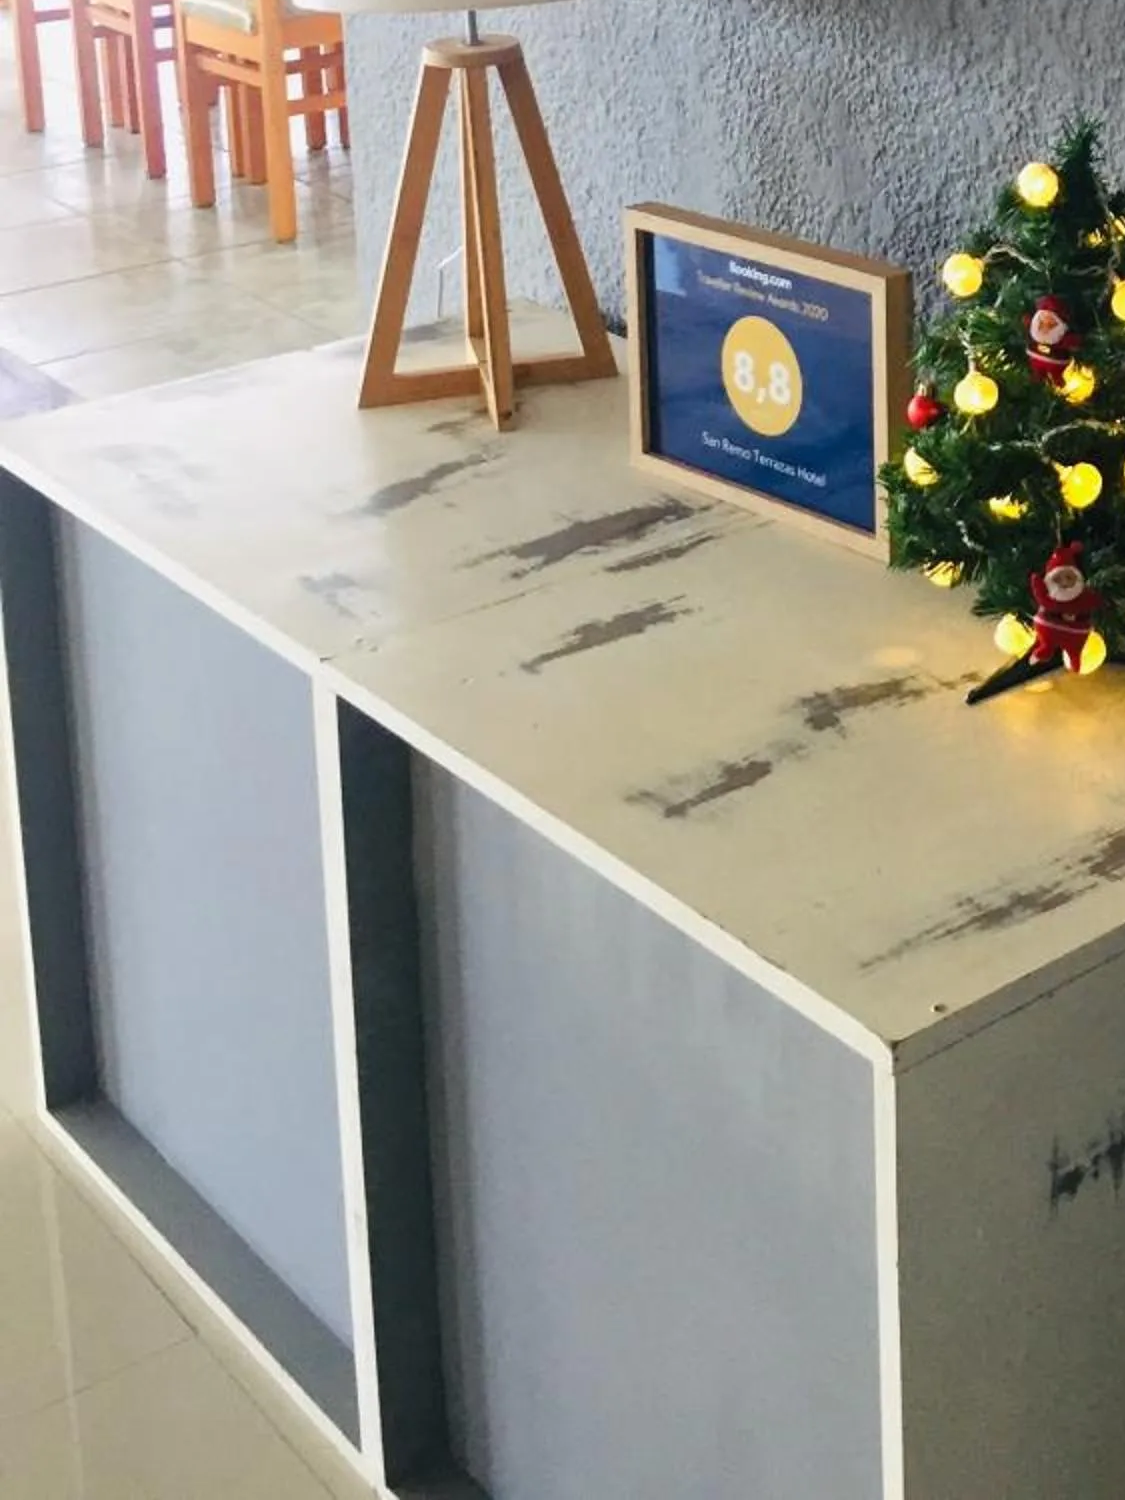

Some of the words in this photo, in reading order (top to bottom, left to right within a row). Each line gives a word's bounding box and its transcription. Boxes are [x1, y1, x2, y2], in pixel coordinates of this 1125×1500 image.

[729, 260, 793, 289] Booking.com
[734, 350, 791, 405] 8,8
[702, 431, 720, 449] San
[722, 438, 750, 460] Remo
[797, 467, 827, 487] Hotel
